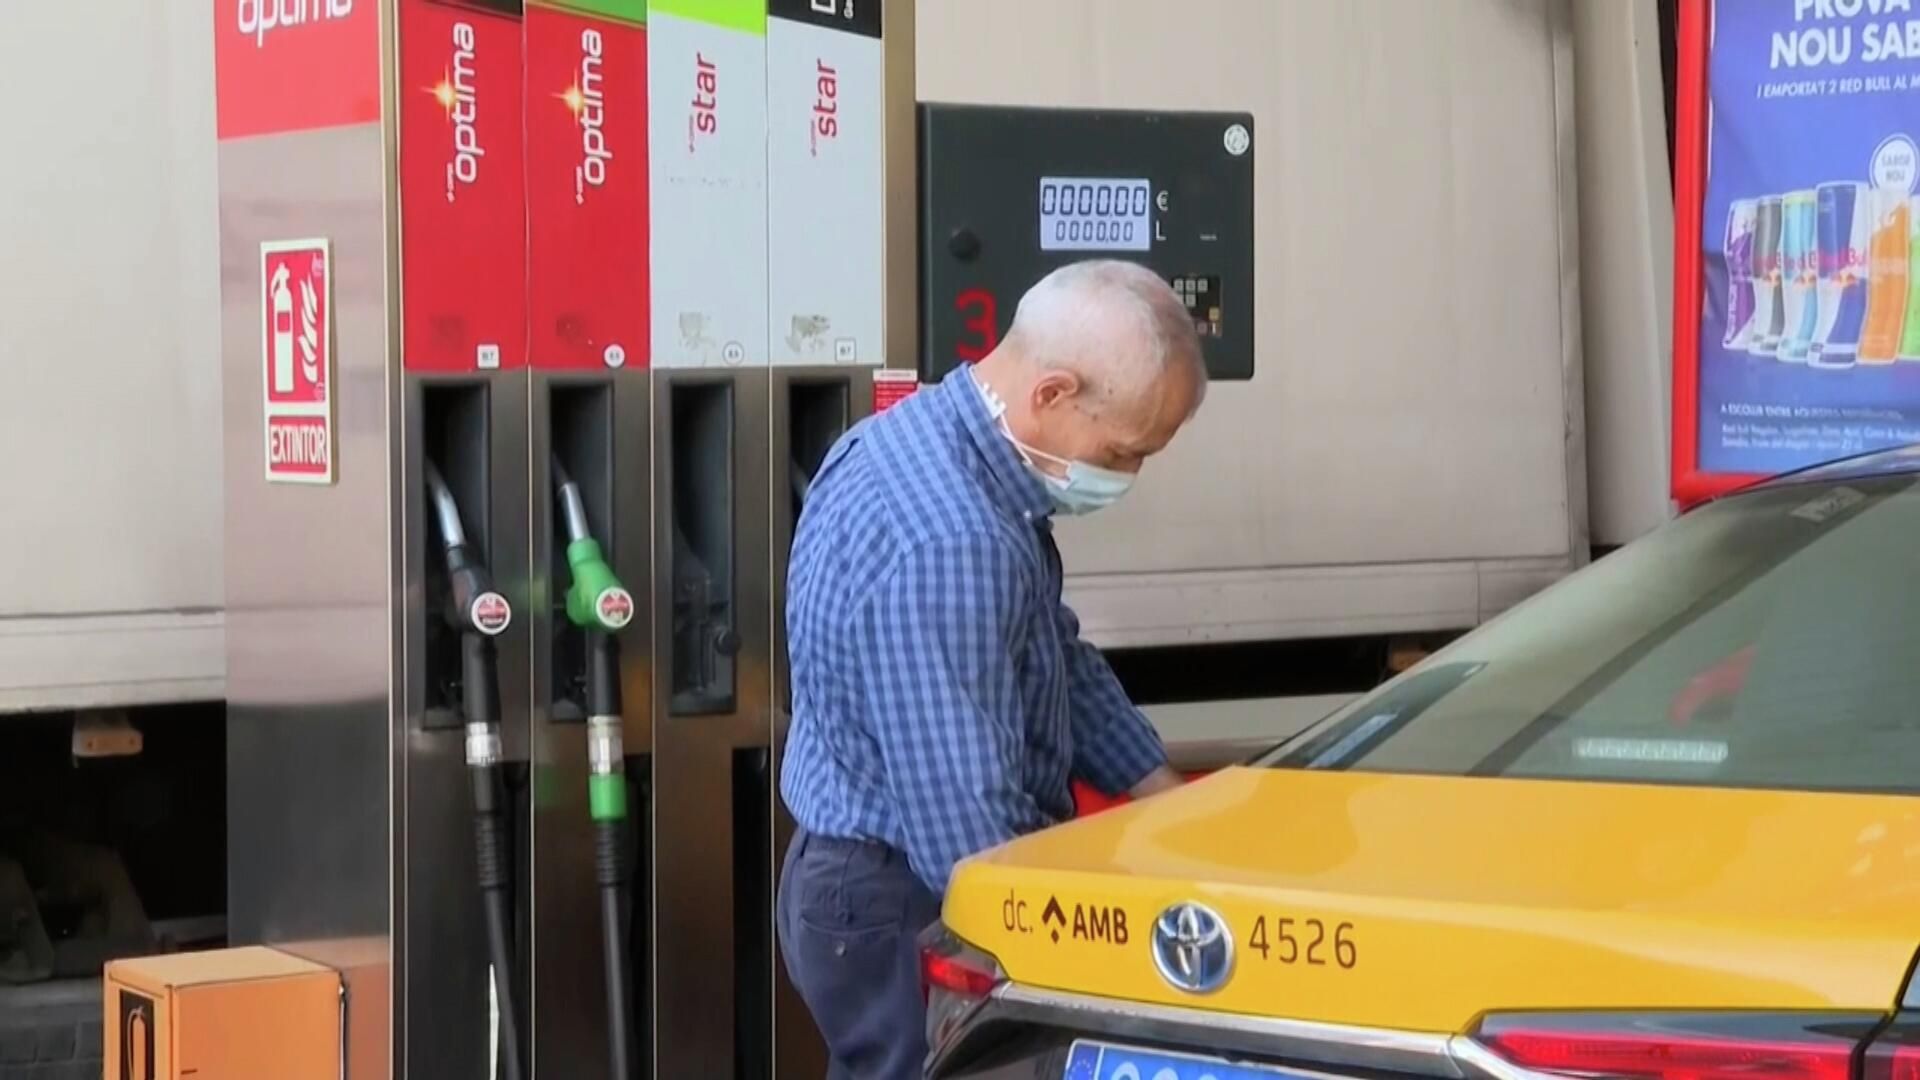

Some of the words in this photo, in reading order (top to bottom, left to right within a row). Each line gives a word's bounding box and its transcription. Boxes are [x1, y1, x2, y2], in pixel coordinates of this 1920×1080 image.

[1770, 26, 1851, 69] NOU
[452, 22, 484, 183] optima
[581, 29, 613, 185] optima
[692, 52, 716, 134] star
[813, 58, 837, 137] star
[1839, 78, 1862, 94] RED
[1865, 76, 1891, 92] BULL
[1156, 190, 1169, 211] €
[1156, 220, 1167, 241] L
[954, 287, 997, 361] 3
[270, 424, 326, 465] EXTINTOR
[1003, 889, 1033, 933] dc.
[1072, 903, 1129, 945] AMB
[1248, 914, 1357, 969] 4526
